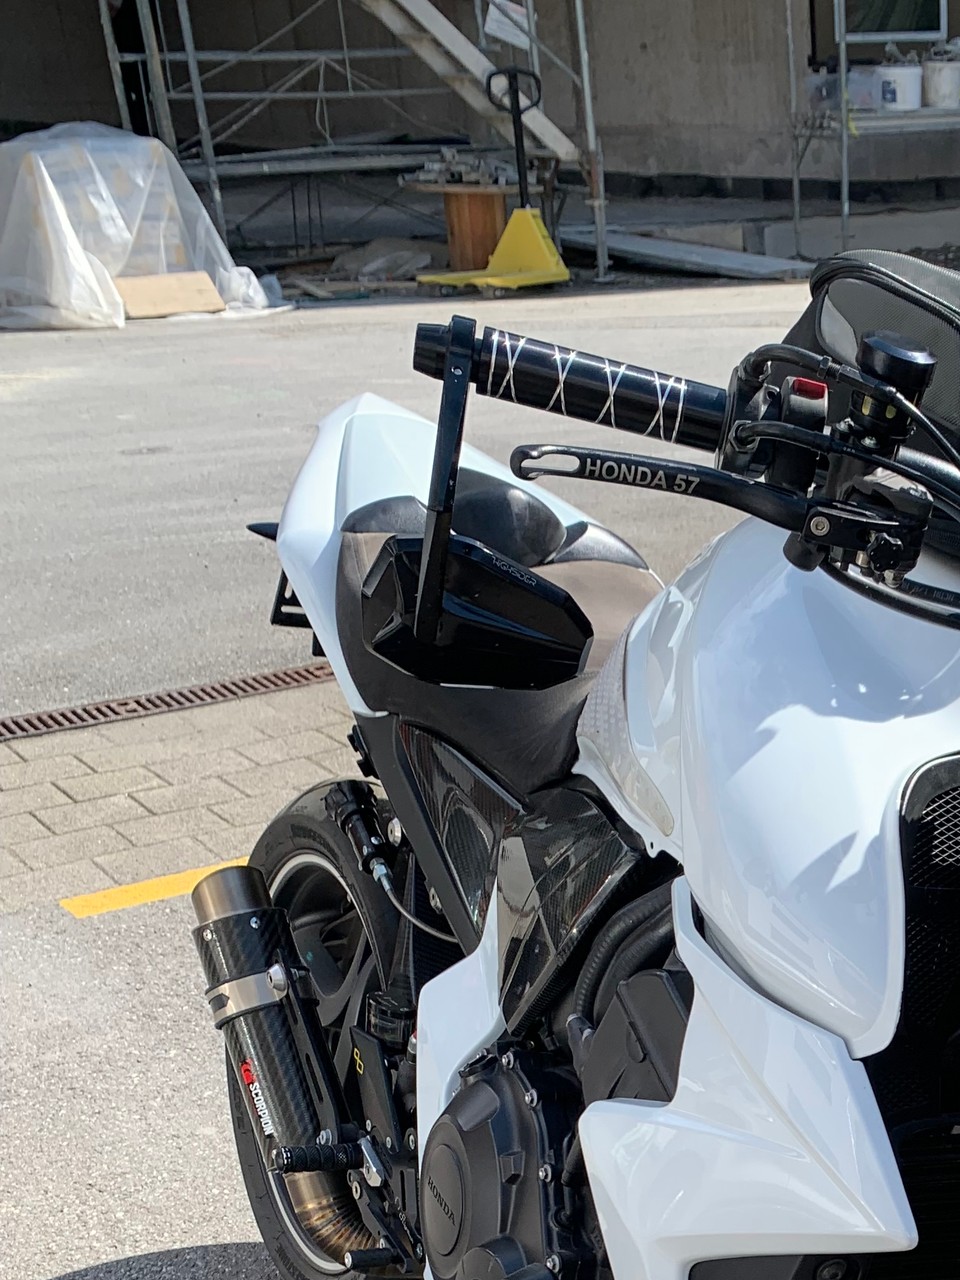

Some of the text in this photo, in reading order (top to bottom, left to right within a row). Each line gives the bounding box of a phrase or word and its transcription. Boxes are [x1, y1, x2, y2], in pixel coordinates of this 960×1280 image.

[584, 458, 700, 494] HONDA 57
[249, 1082, 275, 1136] SCORPION
[427, 1175, 456, 1227] HONDA
